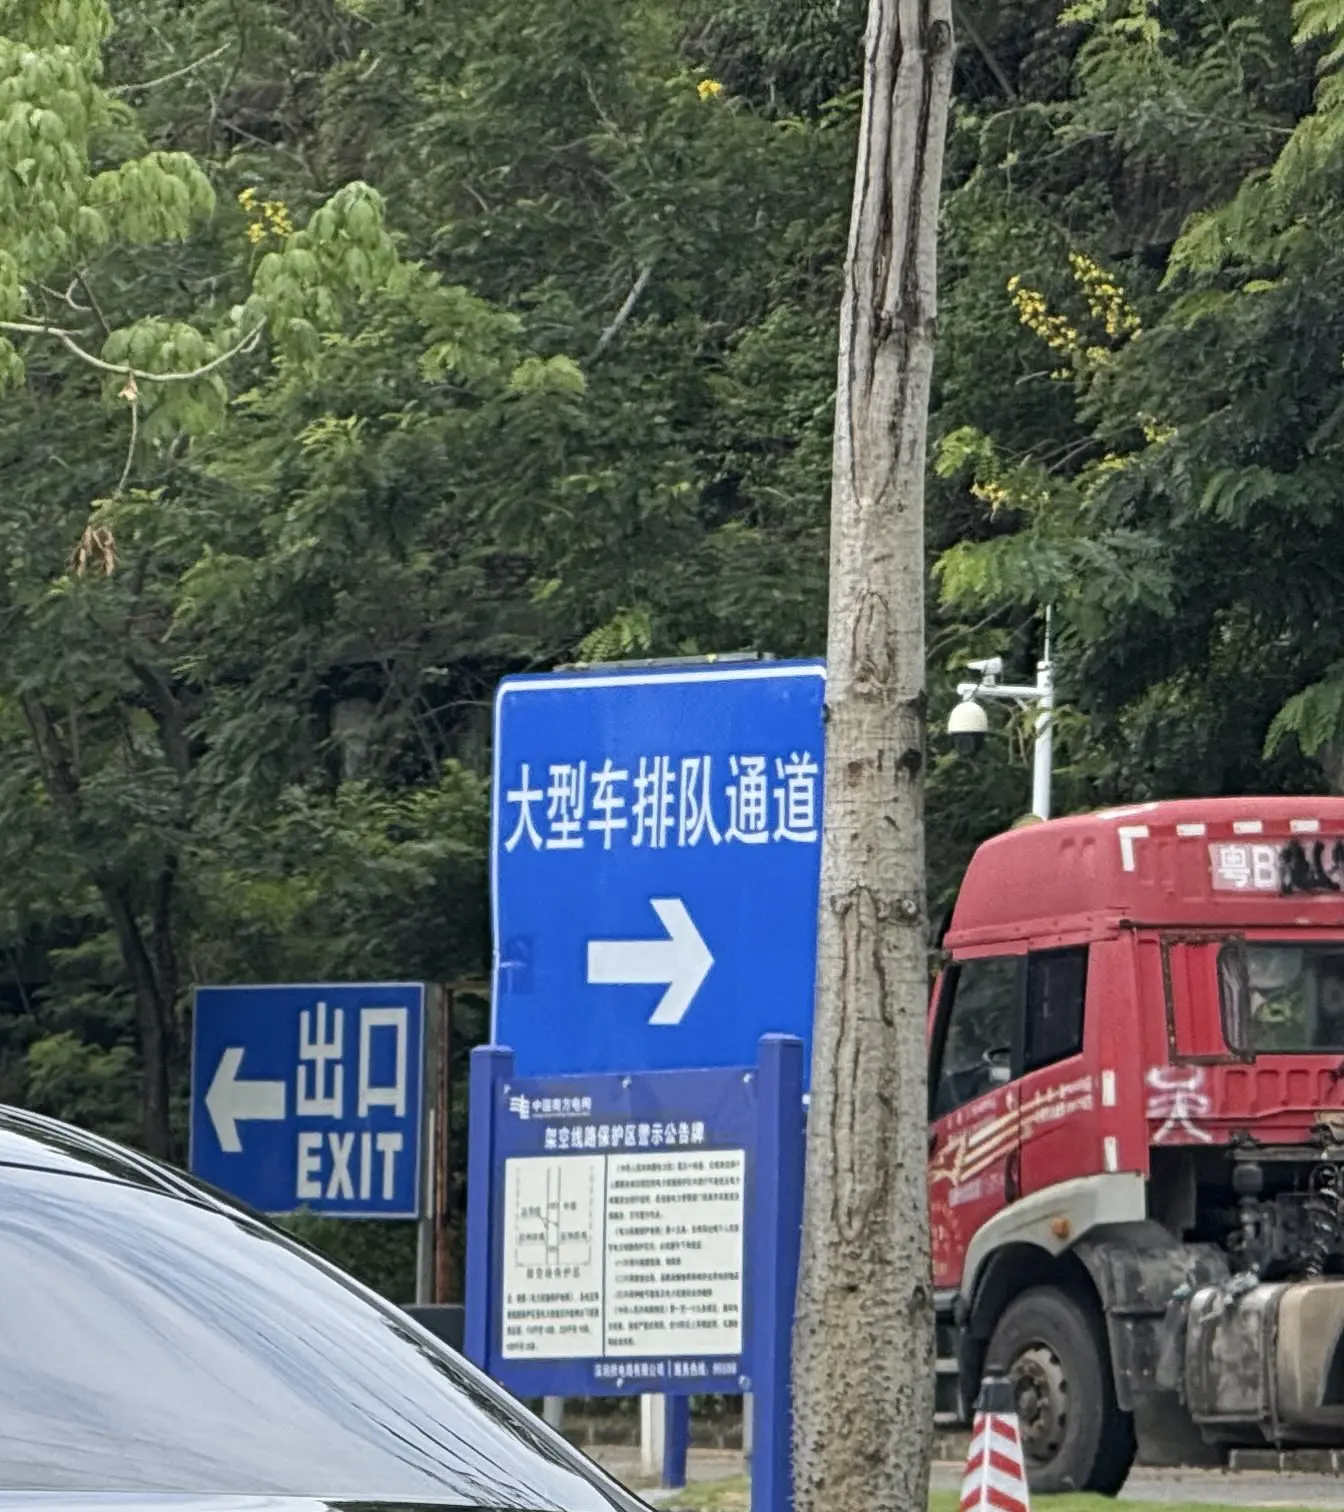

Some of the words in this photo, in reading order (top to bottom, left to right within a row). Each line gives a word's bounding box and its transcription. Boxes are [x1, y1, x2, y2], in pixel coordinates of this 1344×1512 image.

[503, 750, 820, 853] 大型车排队通道
[296, 1001, 408, 1119] 出口
[296, 1132, 403, 1200] EXIT
[544, 1120, 705, 1150] 架空线路保护区警示公告牌
